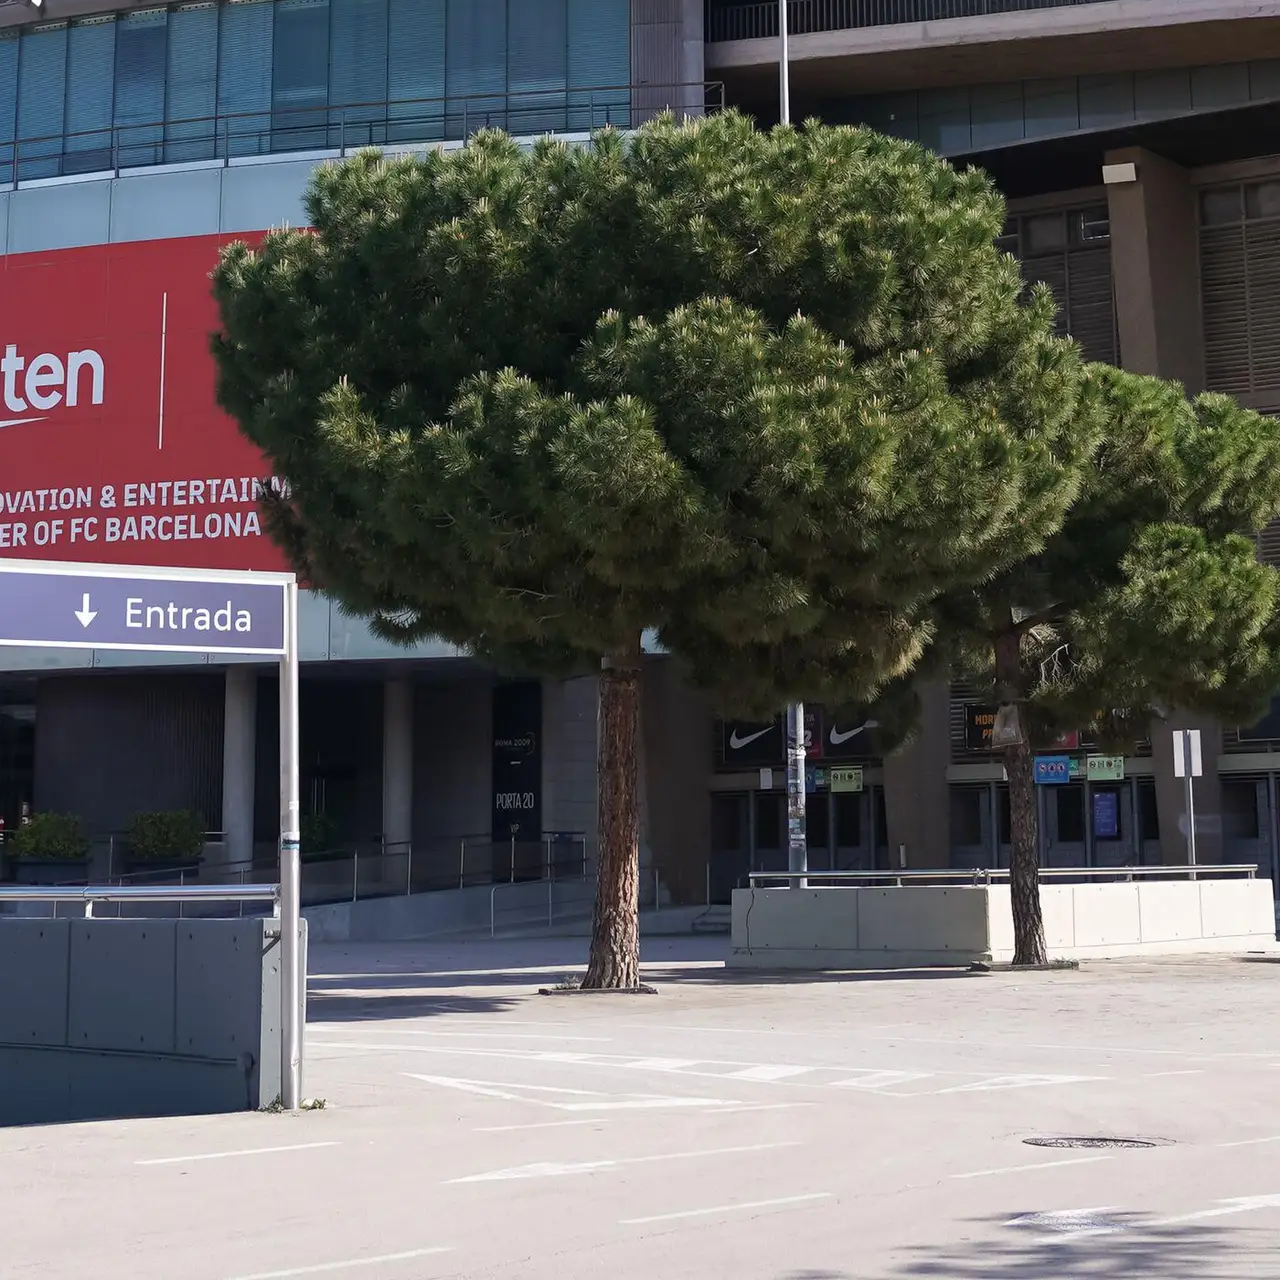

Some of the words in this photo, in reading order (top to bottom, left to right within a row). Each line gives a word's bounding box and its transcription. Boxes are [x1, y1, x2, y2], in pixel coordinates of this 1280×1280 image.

[99, 485, 117, 508] &
[33, 519, 64, 546] OF
[70, 517, 98, 543] FC
[105, 511, 262, 542] BARCELONA
[125, 597, 252, 632] Entrada
[496, 793, 522, 809] PORTA
[523, 793, 534, 809] 20
